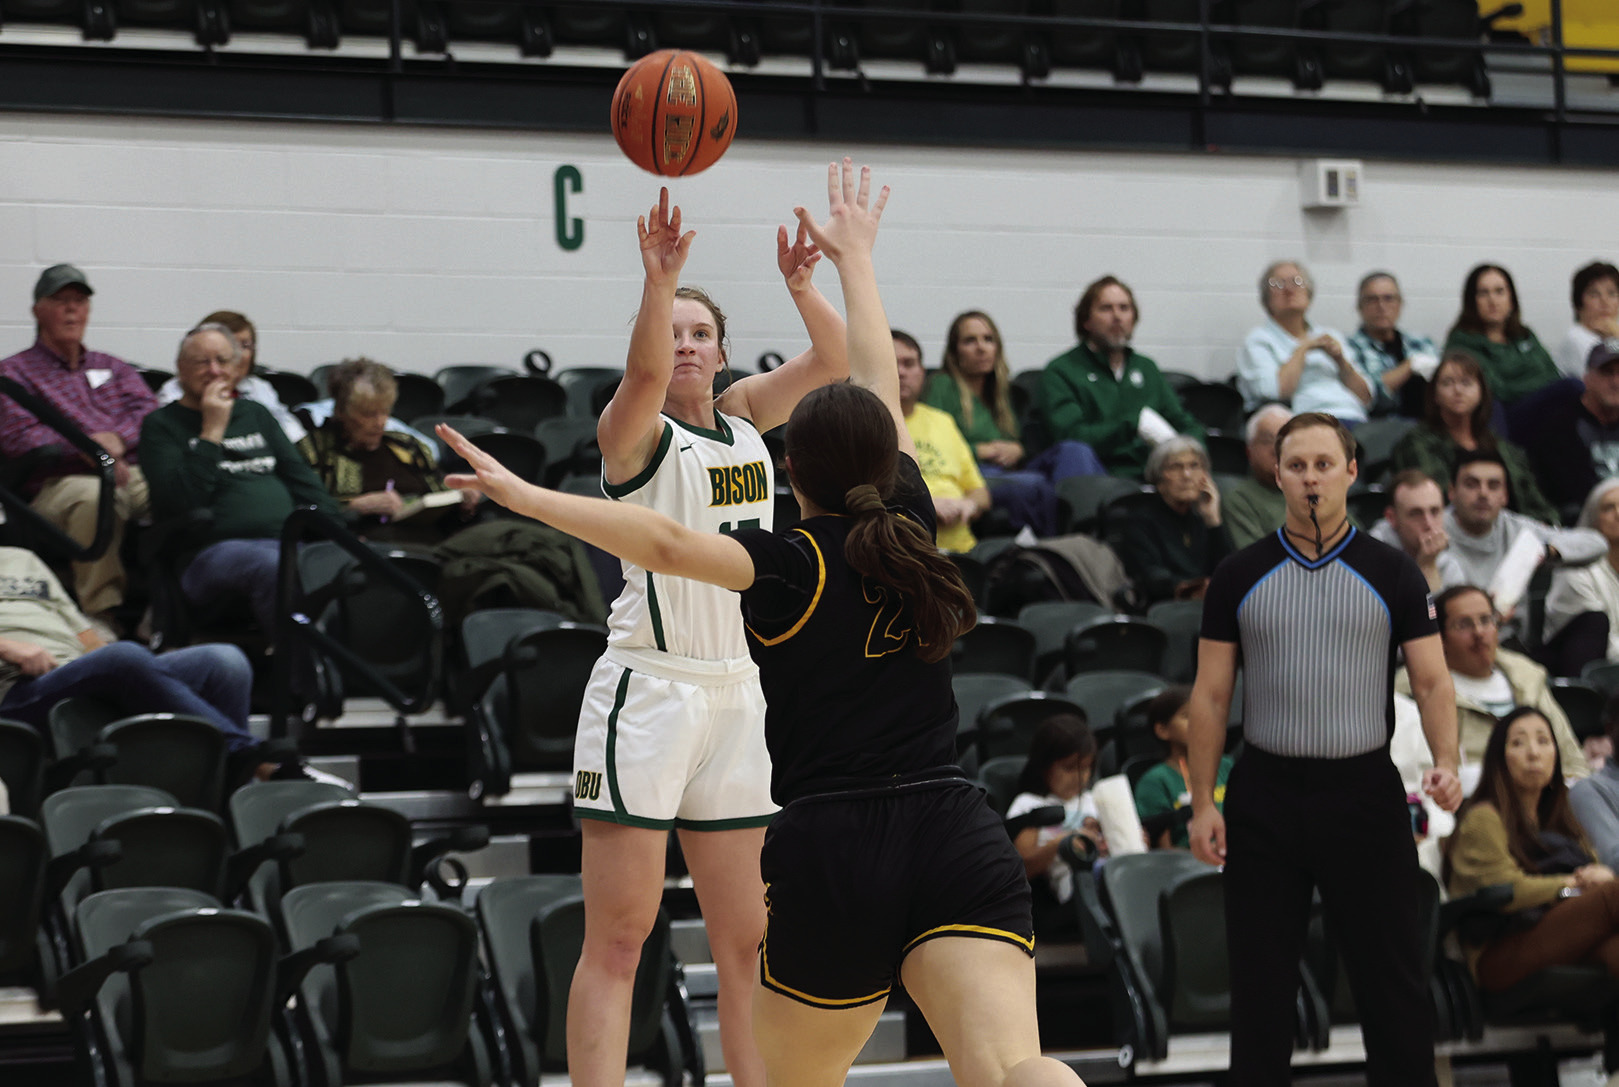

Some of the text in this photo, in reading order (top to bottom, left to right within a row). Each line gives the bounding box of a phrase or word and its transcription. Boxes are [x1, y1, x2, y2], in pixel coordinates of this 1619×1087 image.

[555, 165, 584, 251] C
[706, 461, 768, 507] BISON
[575, 770, 602, 801] OBU
